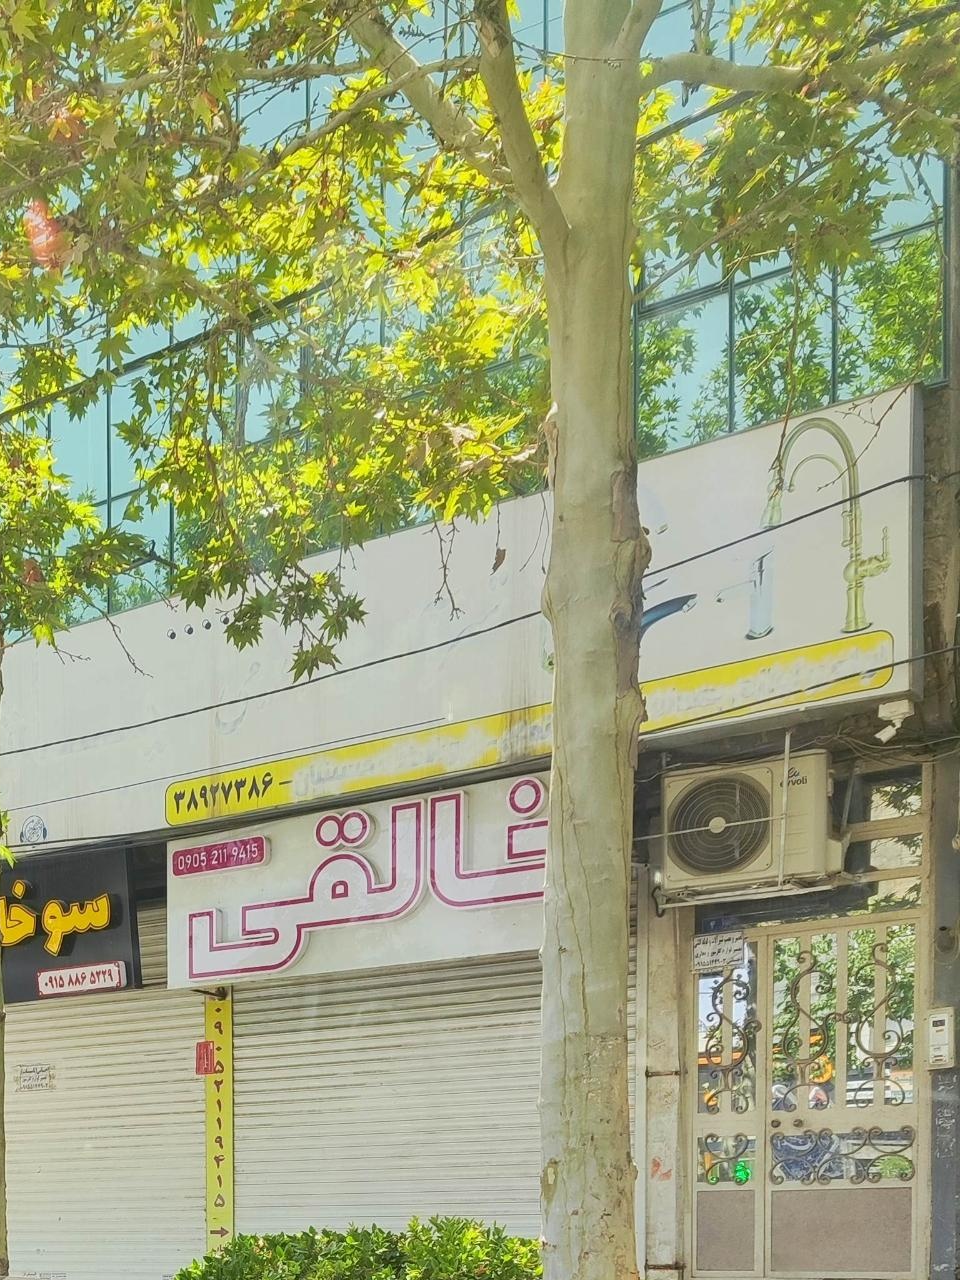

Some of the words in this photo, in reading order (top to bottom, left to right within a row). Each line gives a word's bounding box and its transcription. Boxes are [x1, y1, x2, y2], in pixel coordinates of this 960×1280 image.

[173, 771, 273, 814] ۳۸۹۲۷۳۸۶
[178, 852, 208, 870] 0905
[211, 849, 228, 865] 211
[231, 843, 258, 862] 9415
[44, 975, 65, 989] ۰۹۱۵
[67, 972, 87, 987] ۸۸۶
